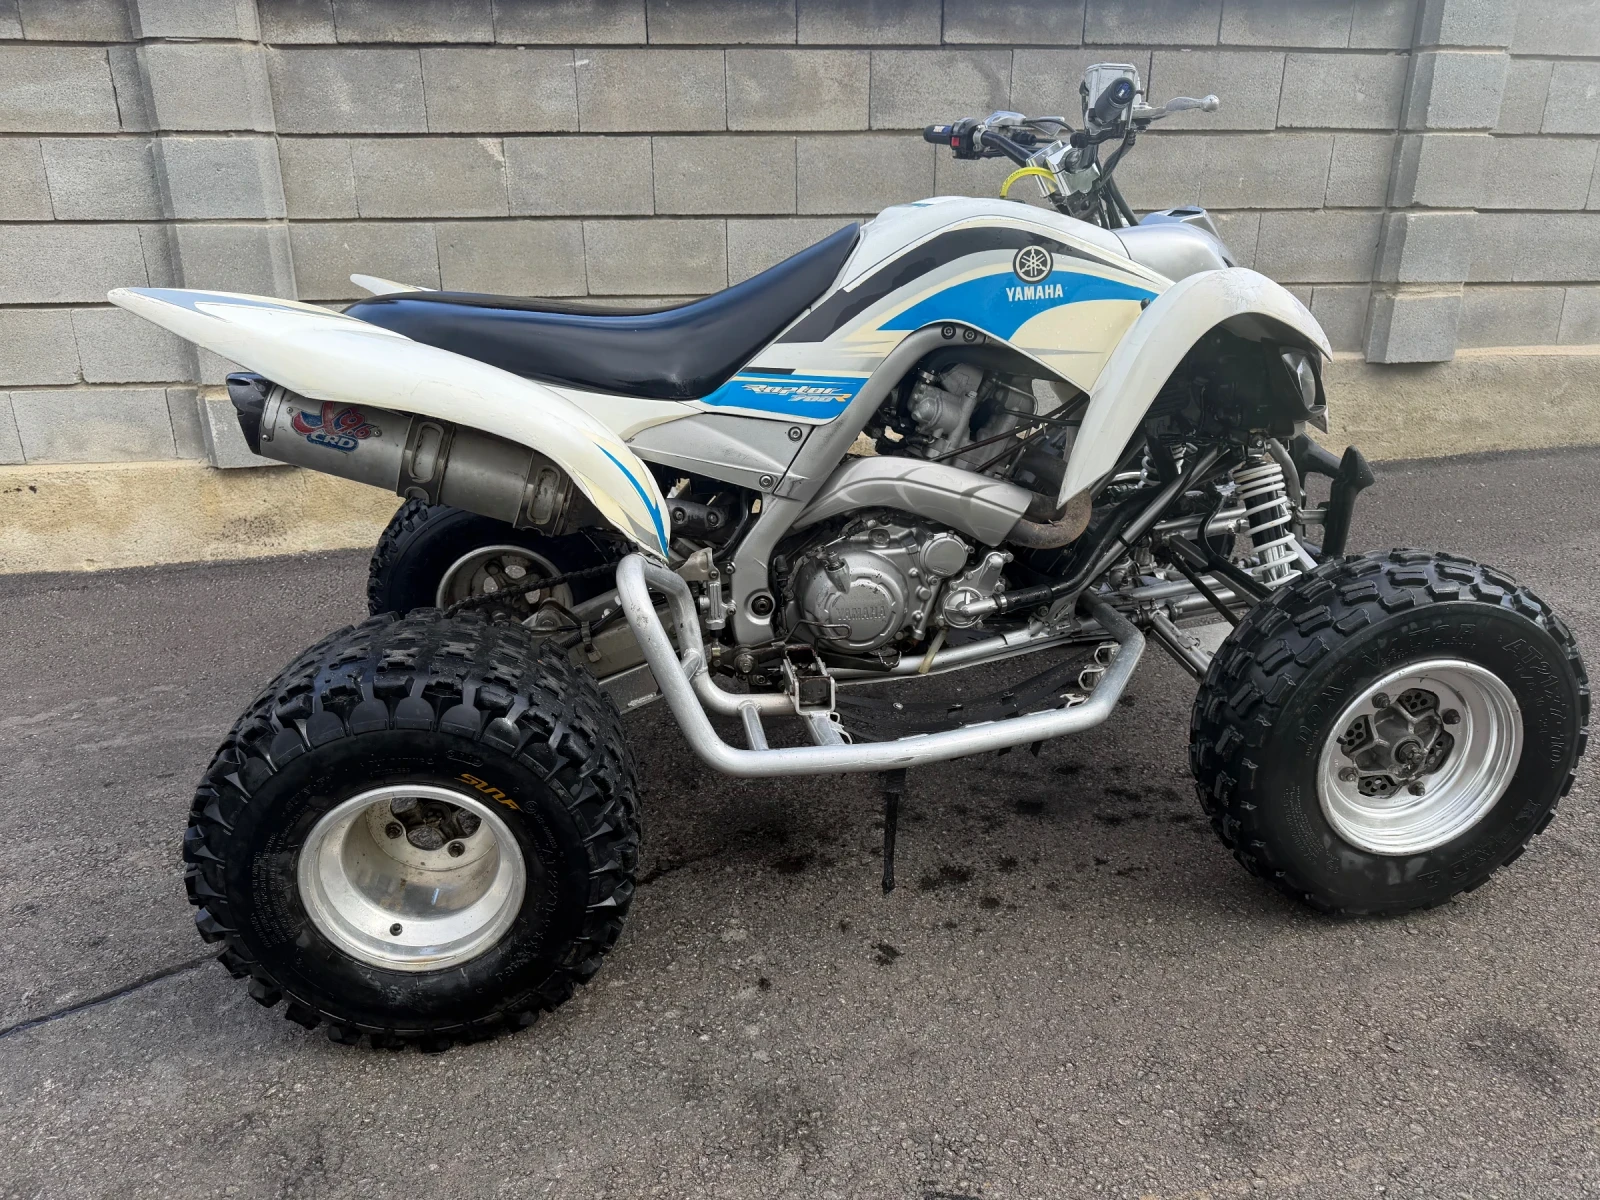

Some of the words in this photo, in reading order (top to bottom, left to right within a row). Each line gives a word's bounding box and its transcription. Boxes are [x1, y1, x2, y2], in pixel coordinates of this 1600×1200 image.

[1006, 284, 1064, 302] YAMAHA
[741, 383, 843, 395] Raptor
[788, 393, 853, 403] 700R
[310, 428, 356, 449] CRD
[836, 605, 887, 621] YAMAHA
